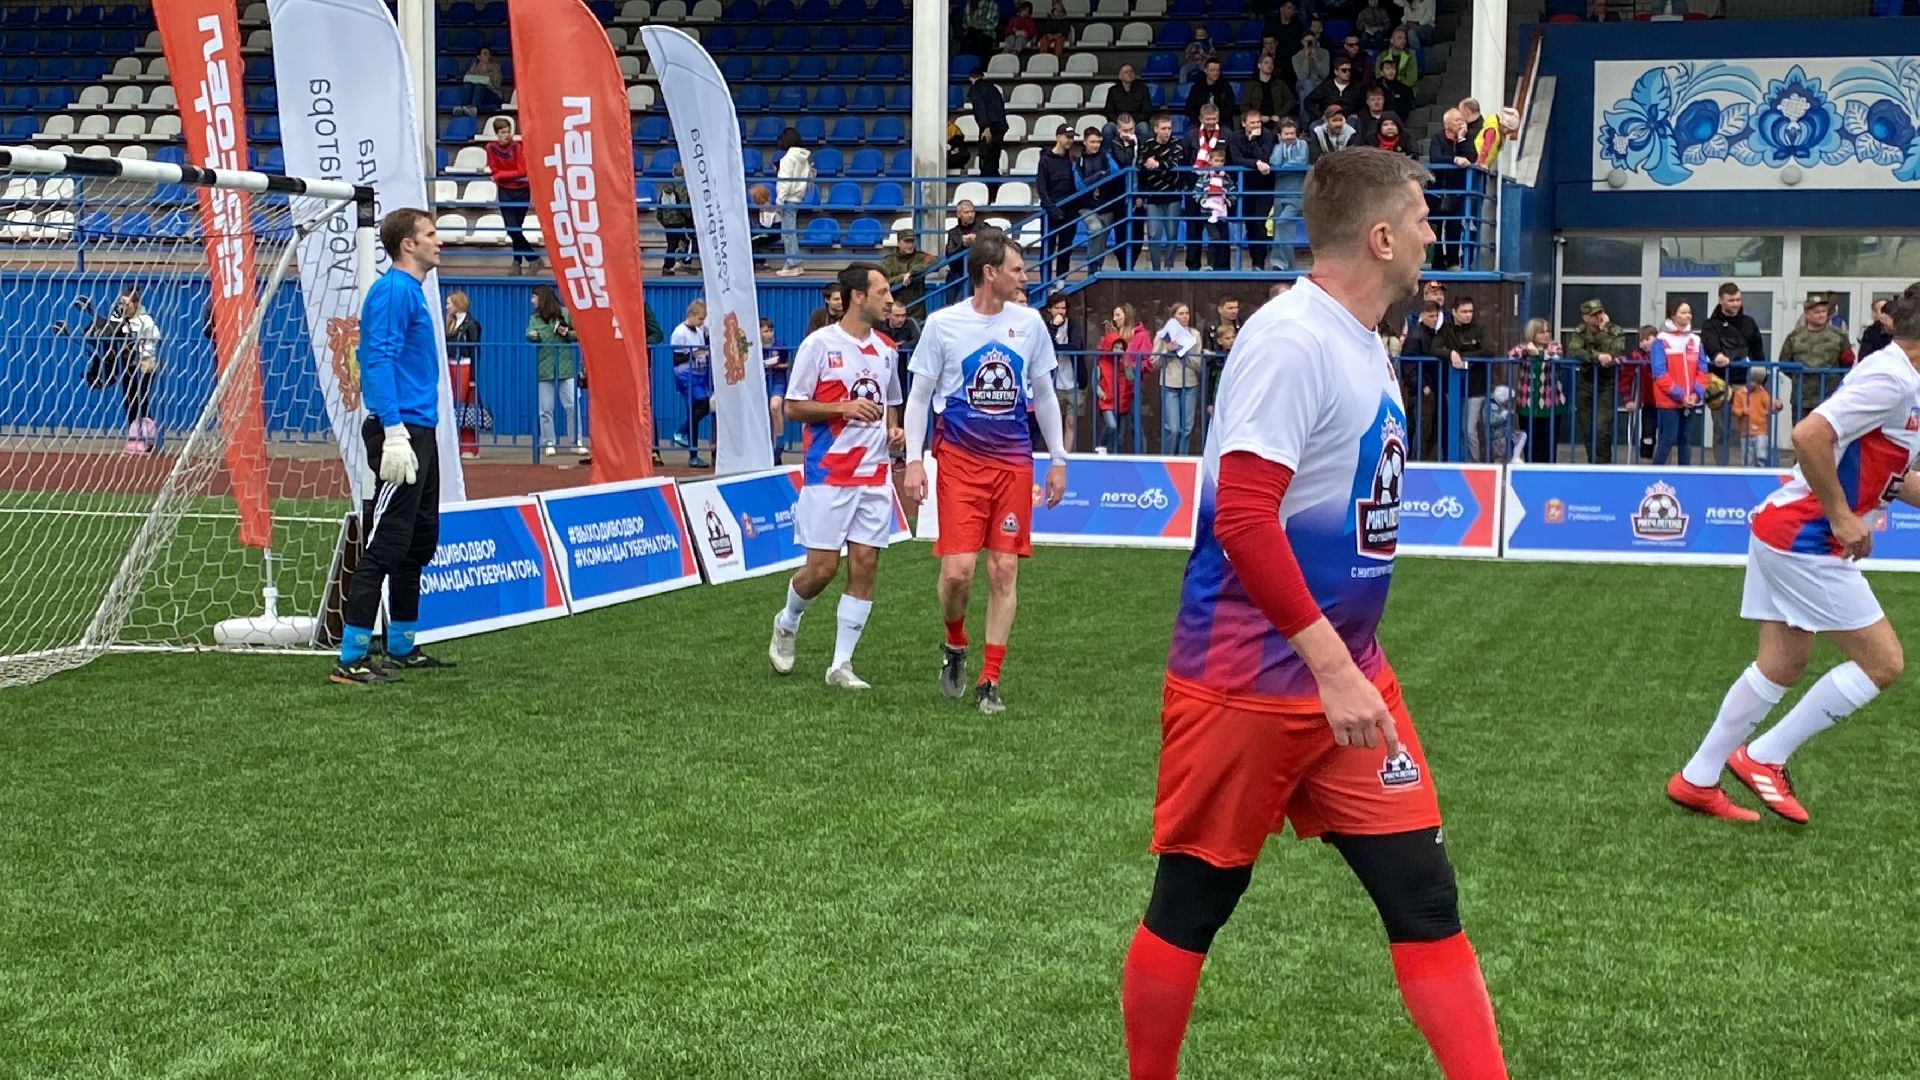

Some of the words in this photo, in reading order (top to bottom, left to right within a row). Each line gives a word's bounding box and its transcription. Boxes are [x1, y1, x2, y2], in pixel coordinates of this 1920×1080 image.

[567, 516, 645, 545] #ВЫХОДИВОДВОР
[427, 539, 497, 569] ОДИВОДВОР
[574, 533, 679, 569] #КОМАНДАГУБЕРНАТОРА
[419, 559, 541, 596] ОМАНДАГУБЕРНАТОРА
